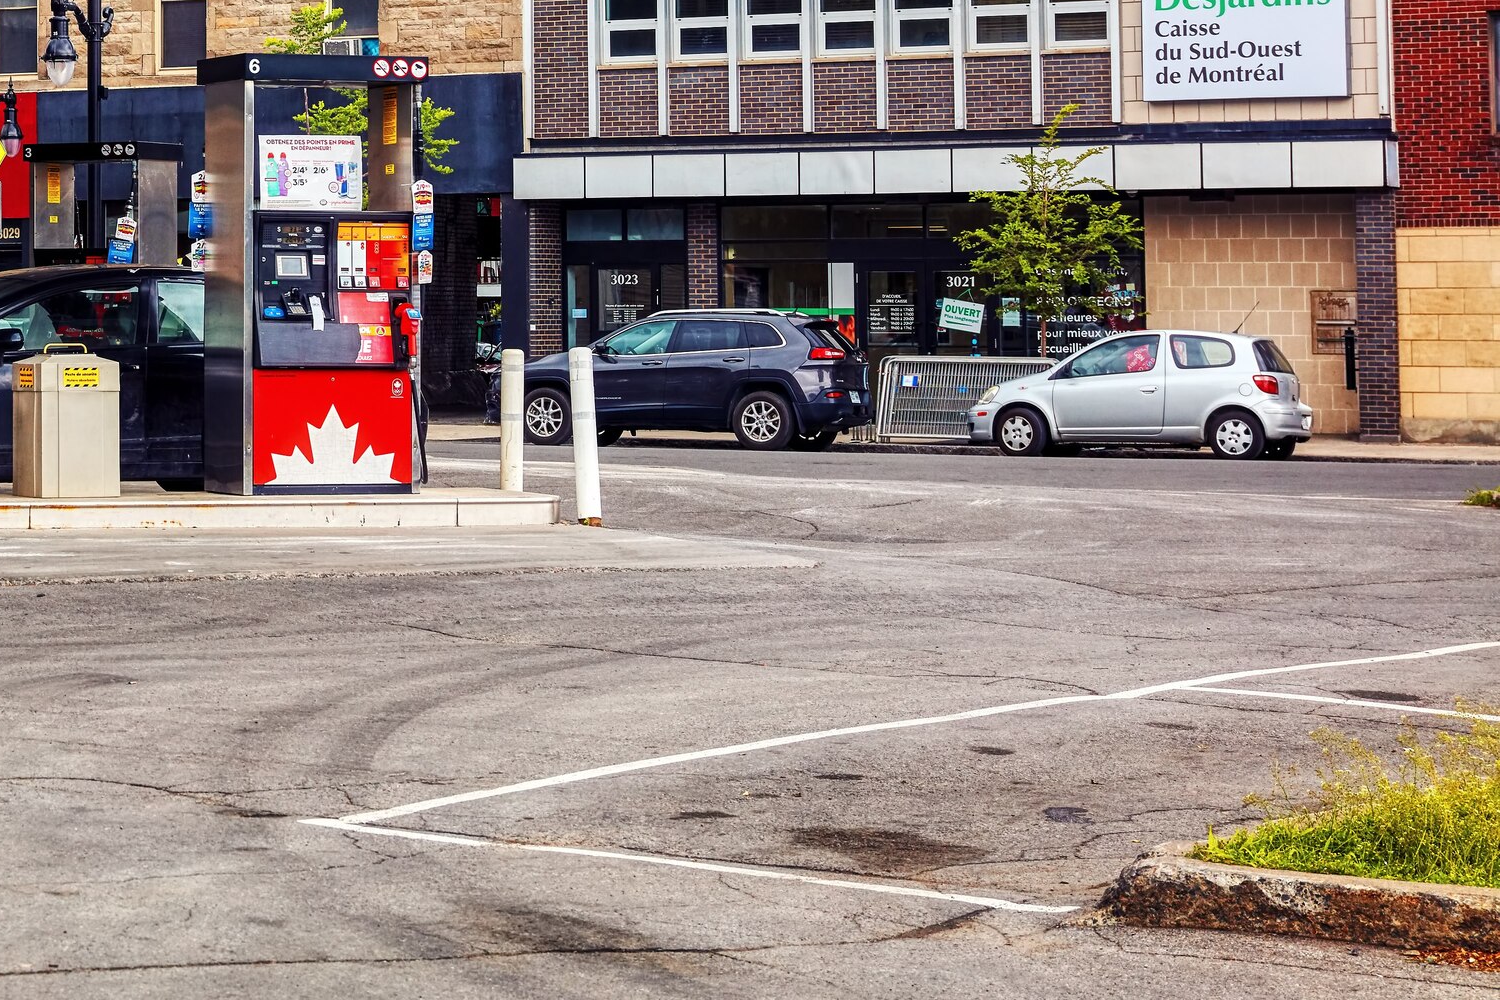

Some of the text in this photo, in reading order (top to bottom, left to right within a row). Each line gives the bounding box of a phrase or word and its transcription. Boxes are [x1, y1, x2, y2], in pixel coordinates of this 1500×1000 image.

[1155, 20, 1221, 37] Caisse
[1155, 40, 1302, 61] du Sud-Ouest
[249, 59, 260, 74] 6
[1155, 62, 1284, 85] de Montréal
[25, 148, 32, 158] 3
[611, 274, 638, 285] 3023
[946, 276, 975, 287] 3021
[945, 305, 981, 318] OUVERT
[1067, 328, 1102, 338] mieux
